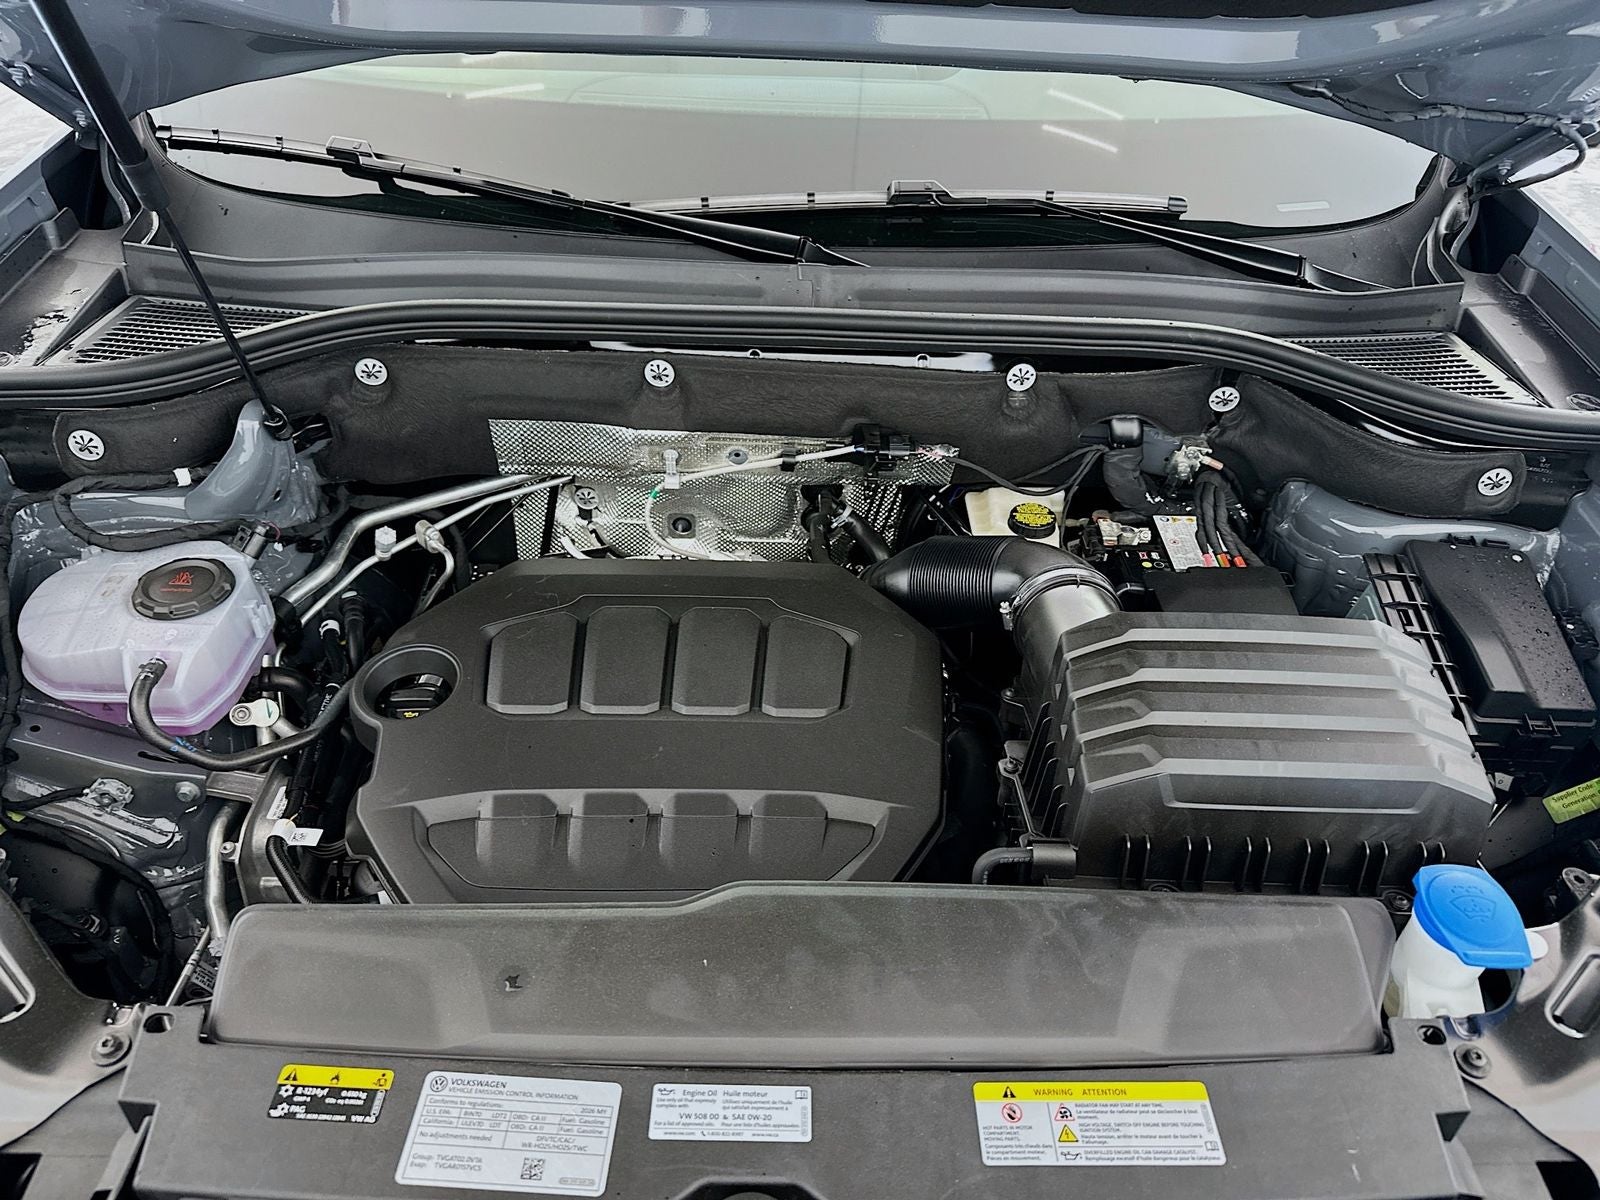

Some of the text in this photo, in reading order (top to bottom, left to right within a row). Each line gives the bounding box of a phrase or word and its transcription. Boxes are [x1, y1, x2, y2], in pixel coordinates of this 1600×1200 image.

[451, 1078, 507, 1089] VOLKSWAGEN
[449, 1087, 473, 1095] VEHICLE
[474, 1088, 504, 1096] EMISSION
[683, 1090, 706, 1098] Engine
[1033, 1088, 1126, 1096] WARNING ATTENTION
[491, 1112, 507, 1120] LDT2
[747, 1113, 773, 1121] 0W-20
[429, 1131, 468, 1140] adjustments
